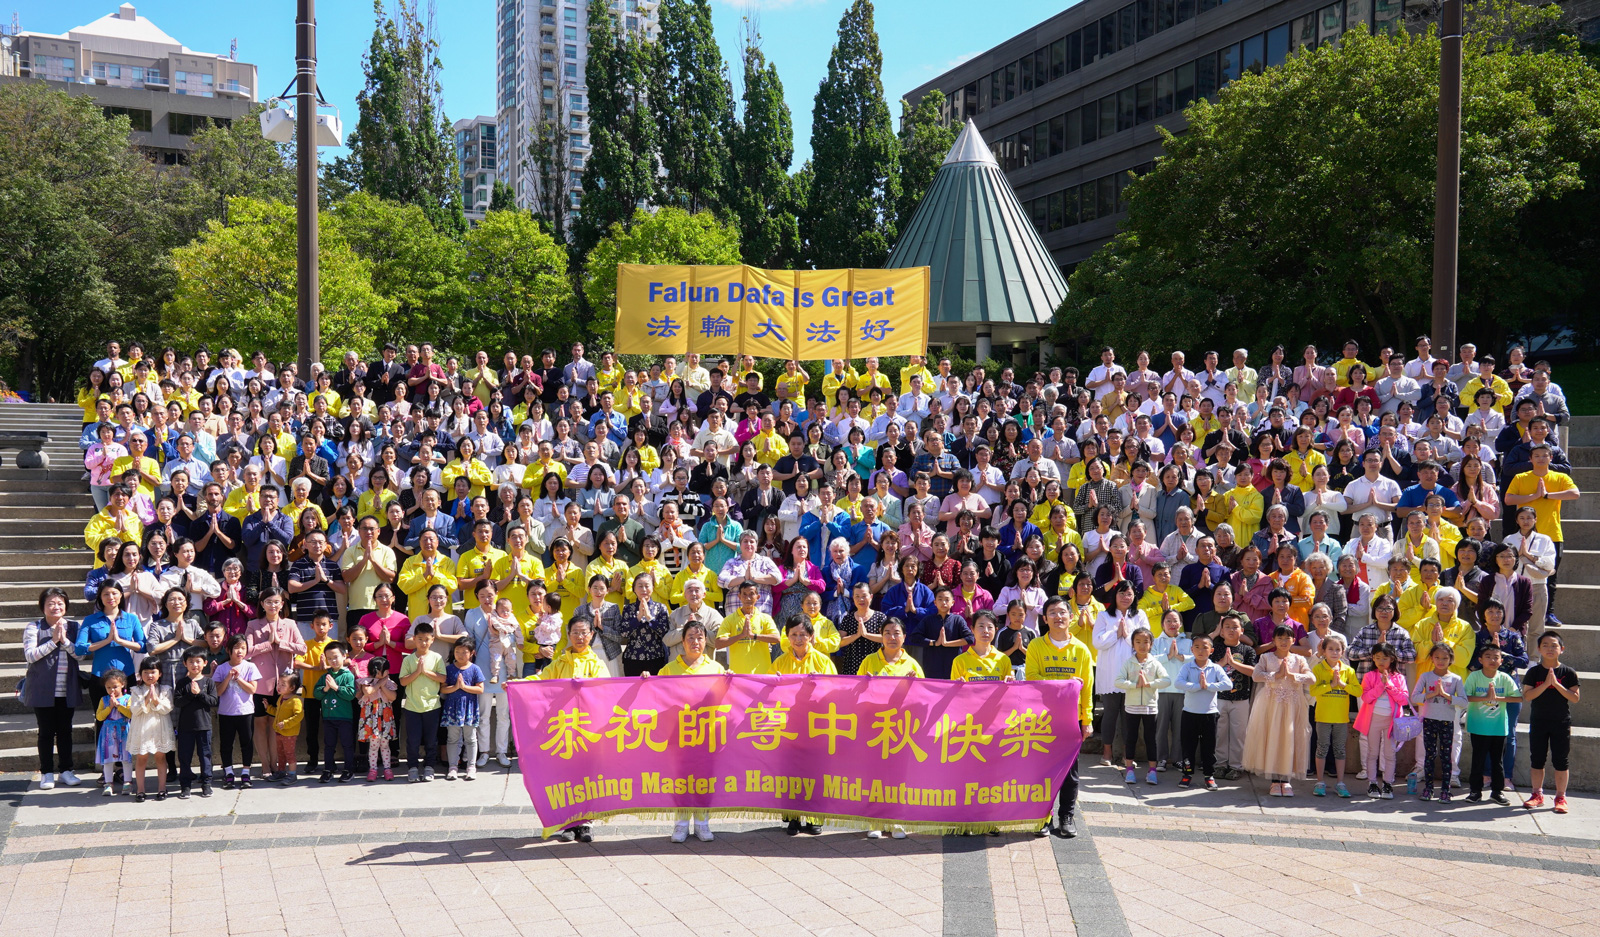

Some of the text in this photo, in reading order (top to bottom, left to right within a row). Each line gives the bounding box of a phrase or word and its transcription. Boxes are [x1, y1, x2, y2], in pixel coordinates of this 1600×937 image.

[649, 281, 895, 308] Falun Dafa Is Great
[647, 314, 895, 342] 法輪大法好
[540, 701, 1057, 763] 恭祝師尊中秋快樂
[545, 770, 1051, 810] Wishing Master a Happy Mid-Autumn Festival
